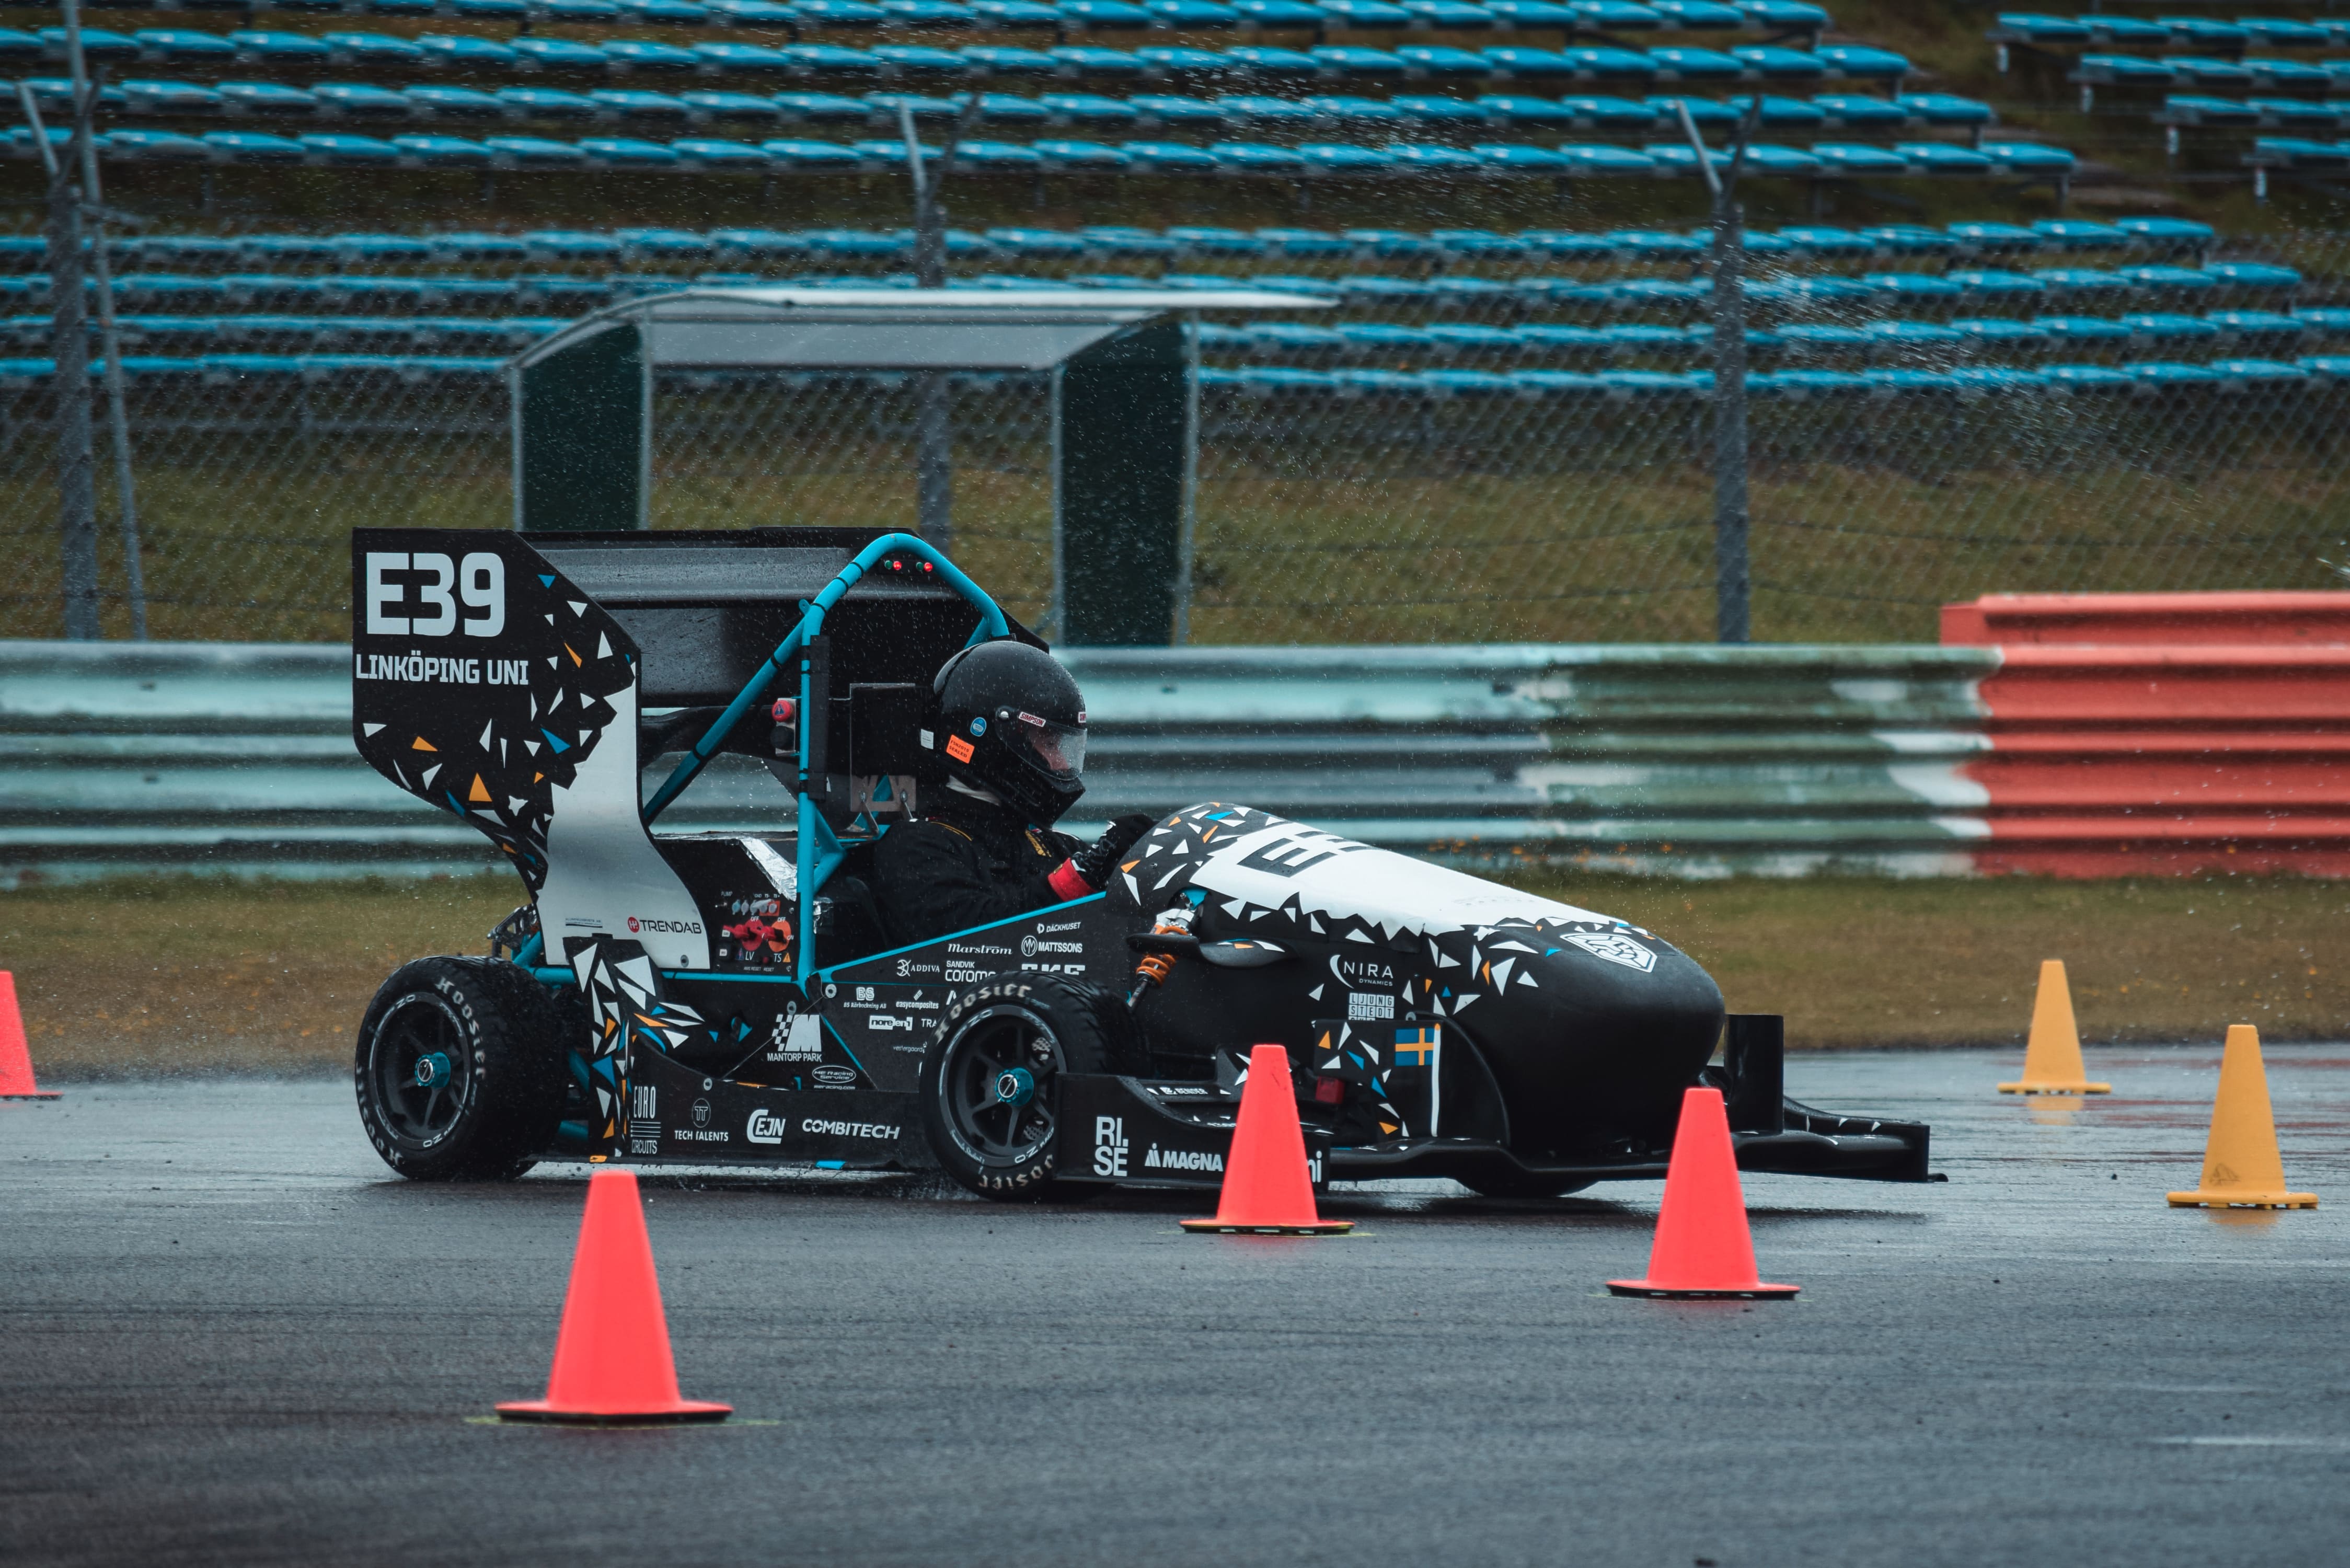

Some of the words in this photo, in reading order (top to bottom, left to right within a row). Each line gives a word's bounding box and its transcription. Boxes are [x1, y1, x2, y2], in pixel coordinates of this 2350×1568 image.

[366, 552, 505, 637] E39
[355, 650, 480, 684] LINKÖPING
[487, 660, 529, 685] UNI
[1021, 713, 1045, 726] SIMPSON
[639, 919, 702, 934] TRENDAB
[1046, 921, 1081, 932] DÄCKHUSET
[1038, 942, 1082, 953] MATTSSONS
[745, 951, 754, 960] LV
[774, 953, 782, 962] TS
[1344, 961, 1393, 978] NIRA
[896, 1001, 939, 1009] easycomposites
[1352, 995, 1392, 1006] LJUNG
[1351, 1006, 1391, 1015] STEDT
[767, 1053, 802, 1062] MANTORP
[803, 1053, 822, 1063] PARK
[633, 1086, 656, 1119] EURO
[674, 1130, 693, 1140] TECH
[802, 1119, 901, 1139] COMBITECH
[1096, 1116, 1128, 1147] RI.
[631, 1140, 657, 1154] CIRCUITS
[1093, 1146, 1128, 1177] SE
[1162, 1150, 1224, 1172] MAGNA
